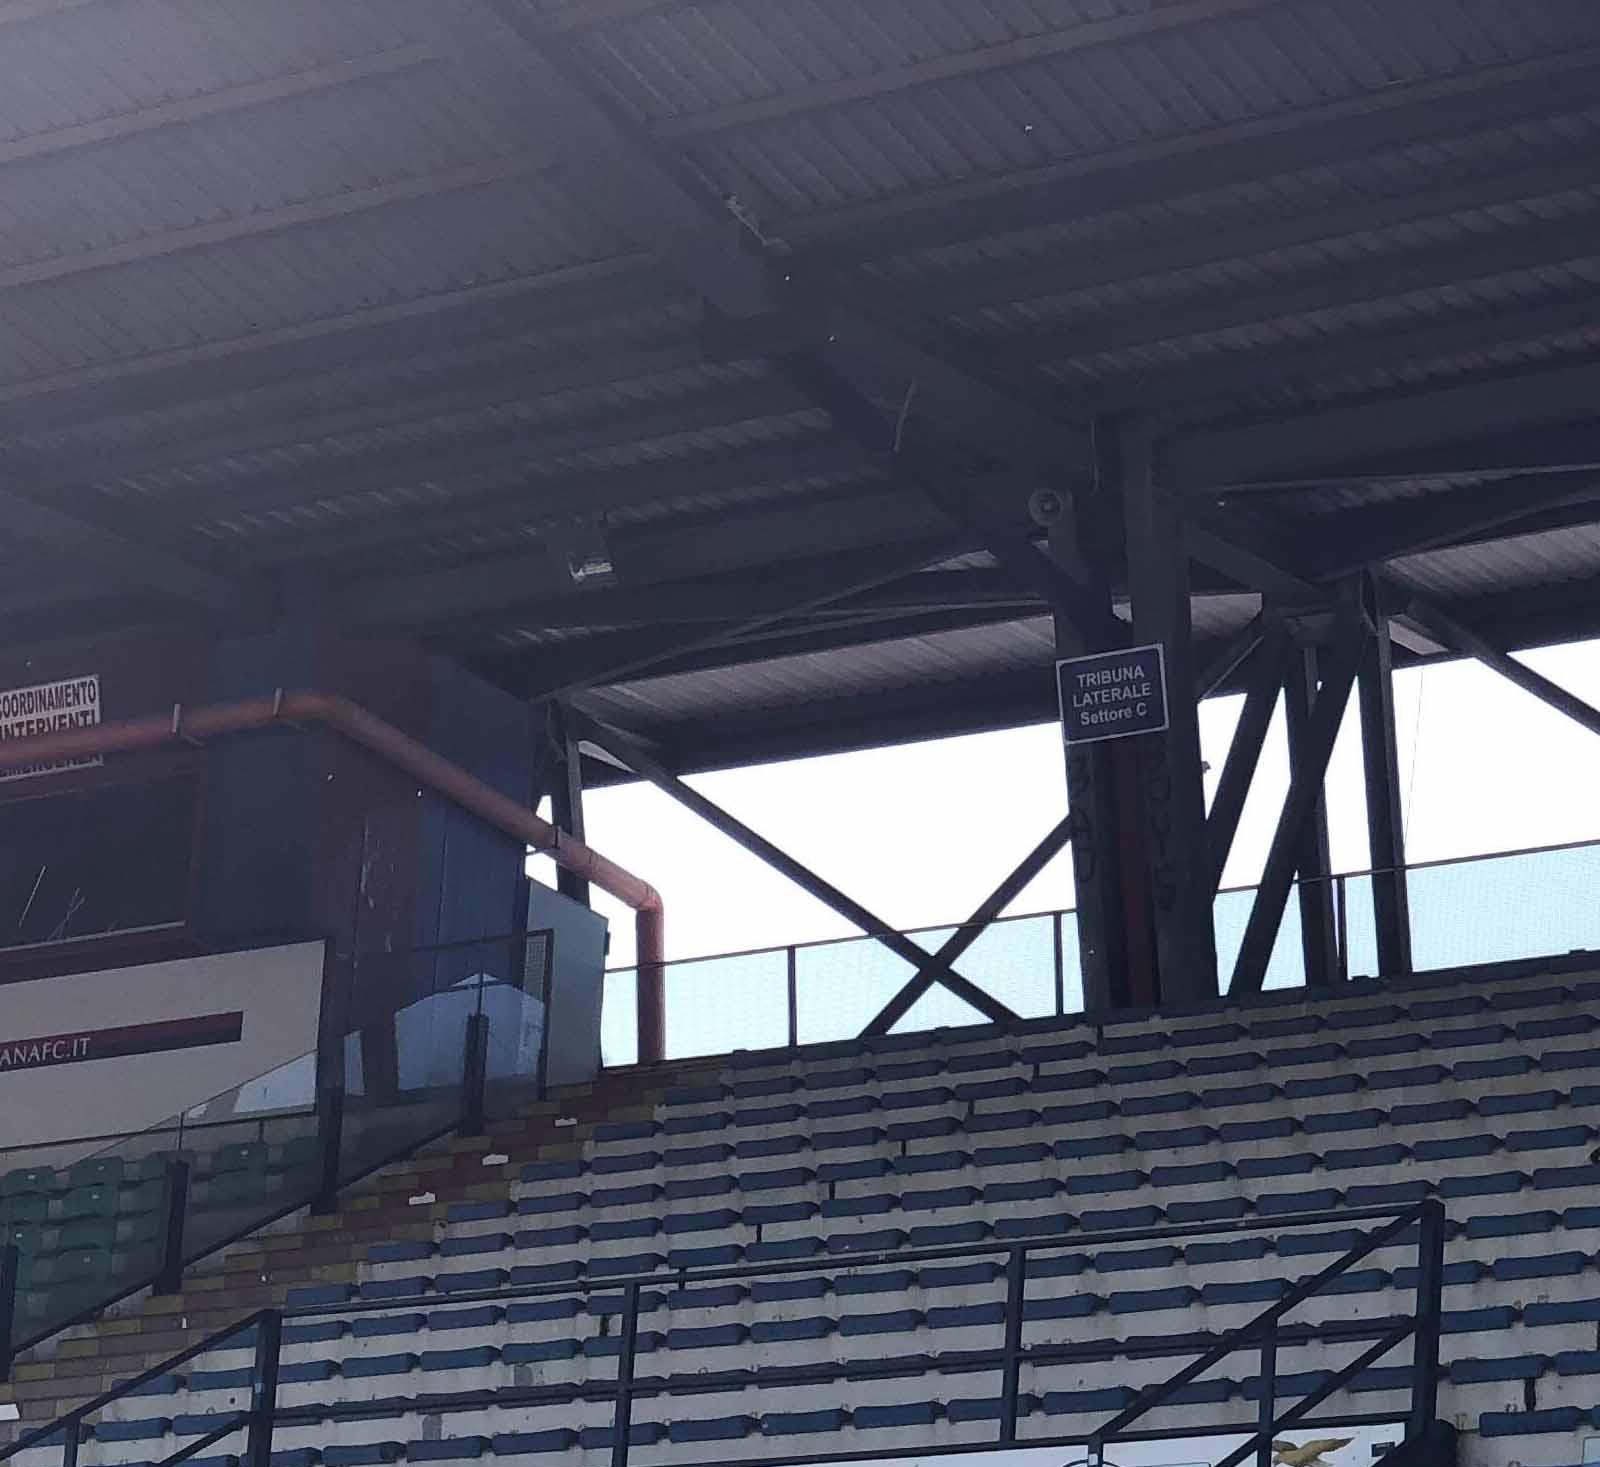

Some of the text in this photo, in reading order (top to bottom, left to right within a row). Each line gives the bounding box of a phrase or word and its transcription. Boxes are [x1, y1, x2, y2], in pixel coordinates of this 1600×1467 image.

[1077, 664, 1145, 690] TRIBUNA
[1073, 682, 1151, 708] LATERALE
[1080, 701, 1148, 726] Settore C
